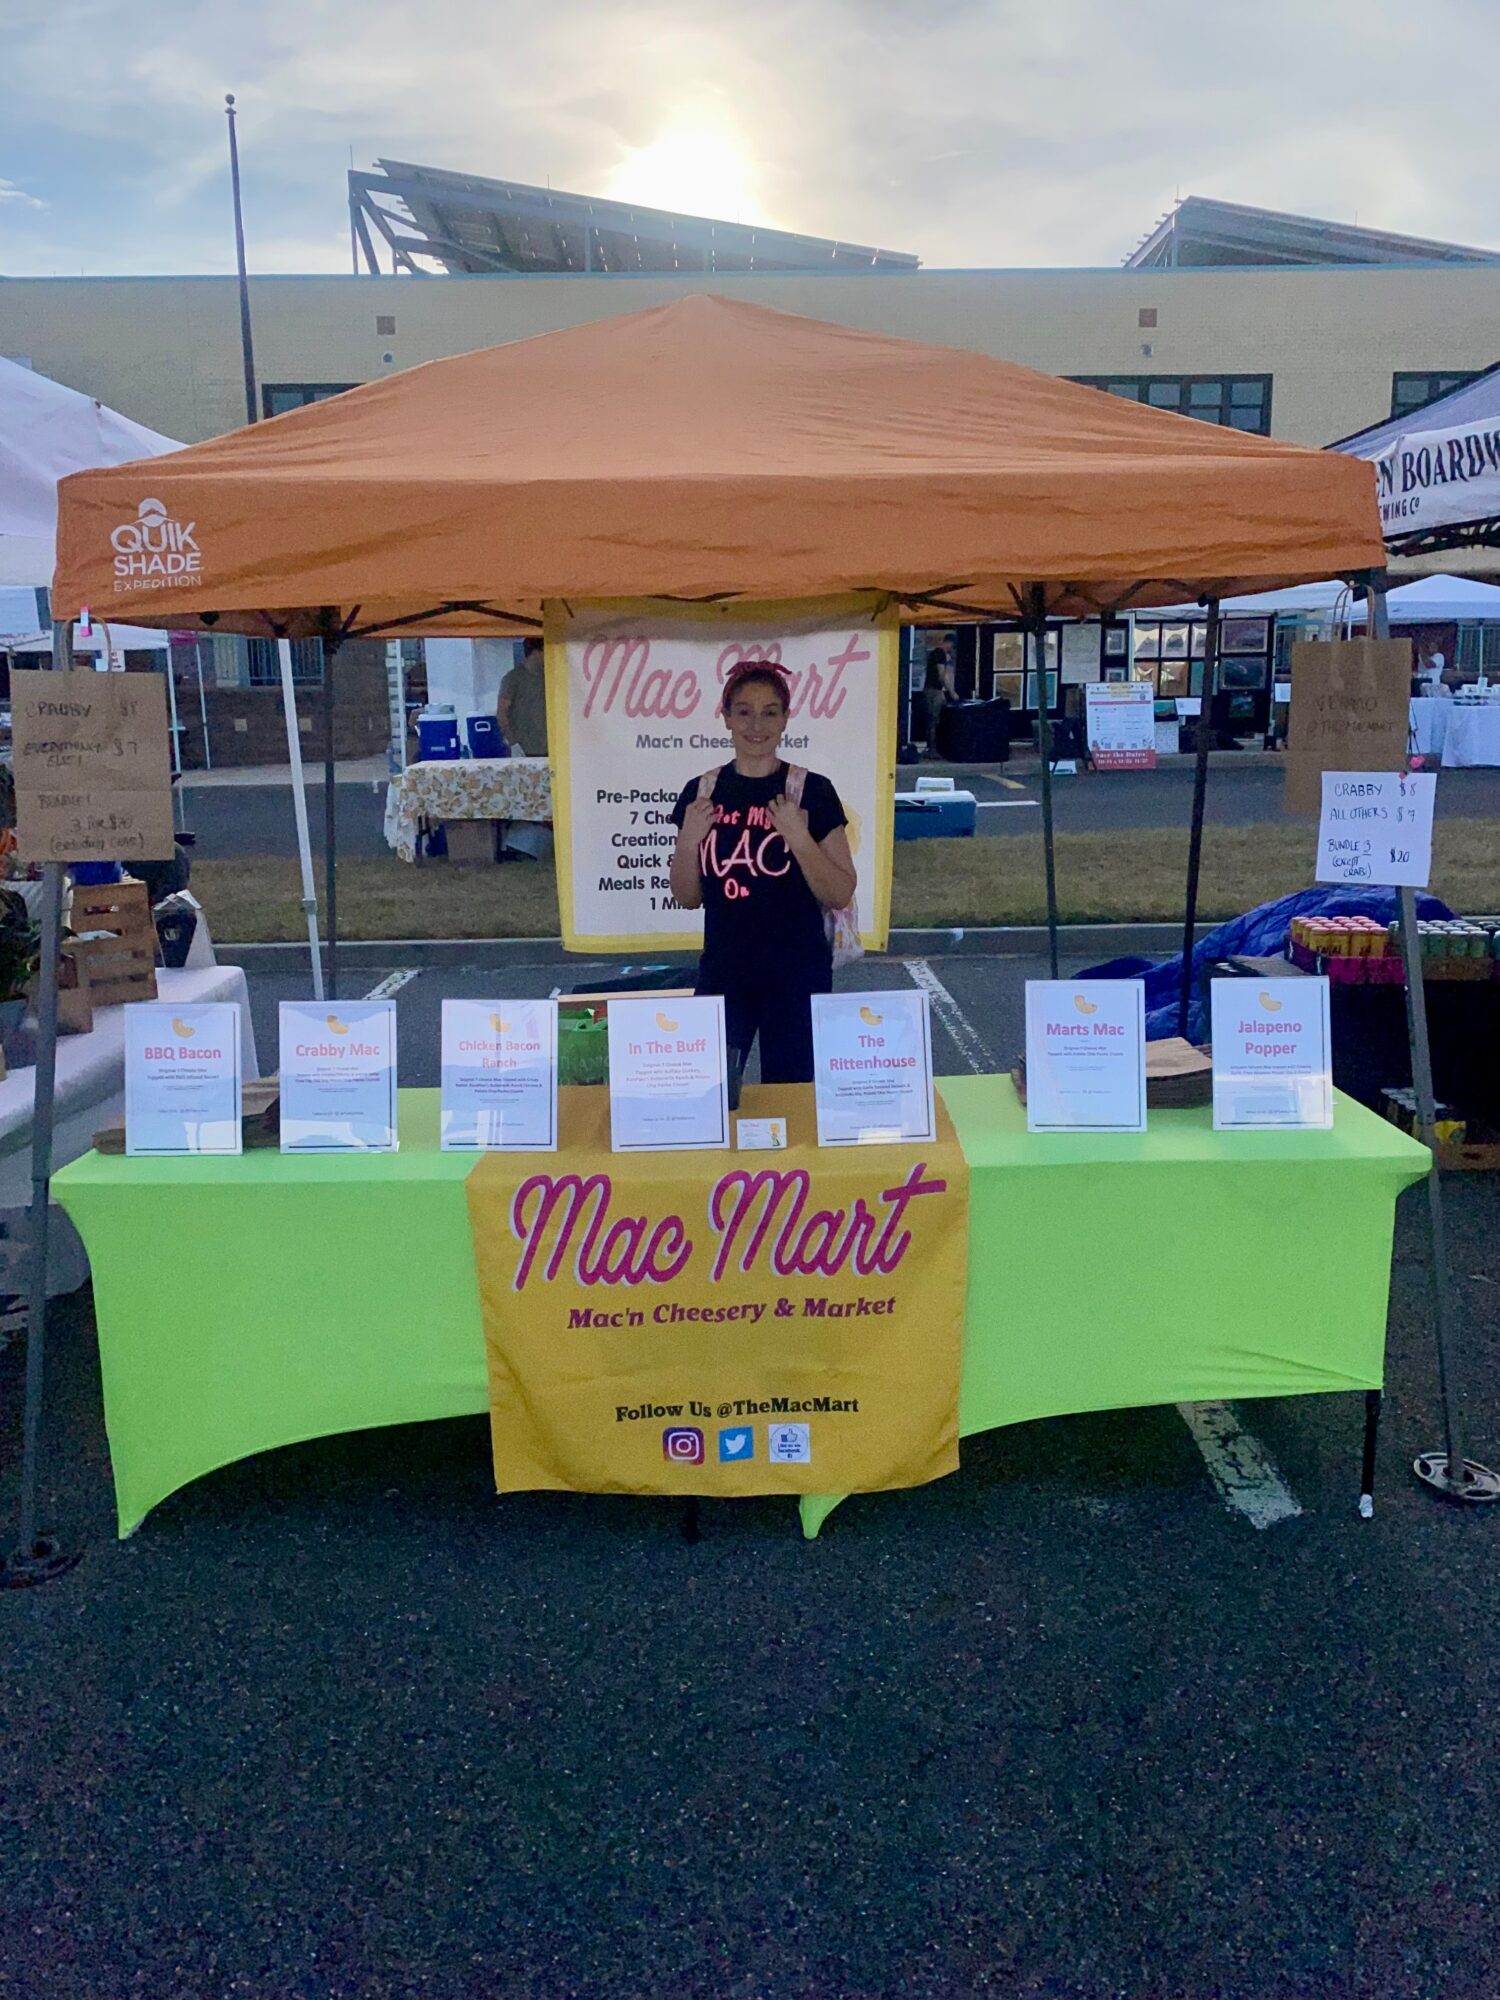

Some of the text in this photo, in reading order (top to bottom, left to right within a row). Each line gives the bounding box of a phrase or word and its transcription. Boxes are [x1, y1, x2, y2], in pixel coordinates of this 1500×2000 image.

[1377, 460, 1393, 497] N
[1379, 499, 1407, 521] WING
[111, 521, 200, 553] QUIK
[114, 552, 203, 576] SHADE
[113, 576, 202, 592] EXPEDITION
[583, 634, 702, 720] Mac
[635, 734, 684, 749] Mac'n
[596, 789, 682, 804] Pre-Packa
[1334, 783, 1383, 797] CRABBY
[629, 811, 639, 825] 7
[1330, 808, 1346, 821] ALL
[1350, 806, 1388, 820] OTHERS
[1327, 839, 1360, 852] BUNDLE
[699, 829, 791, 878] MAC
[1390, 848, 1411, 863] $20
[617, 854, 662, 869] Quick
[598, 876, 645, 891] Meals
[1046, 1023, 1125, 1036] Marts Mac
[1238, 1020, 1302, 1036] Jalapeno
[459, 1040, 541, 1051] Chicken Bacon
[628, 1039, 707, 1055] In The Buff
[858, 1034, 885, 1047] The
[144, 1047, 222, 1060] BBQ Bacon
[295, 1043, 380, 1058] Crabby Mac
[1245, 1041, 1297, 1057] Popper
[482, 1057, 517, 1069] Ranch
[829, 1055, 917, 1071] Rittenhouse
[509, 1162, 947, 1292] Mac Mart
[567, 1296, 896, 1329] Mac'n Cheesery & Market
[616, 1397, 860, 1422] Follow Us @TheMacMart
